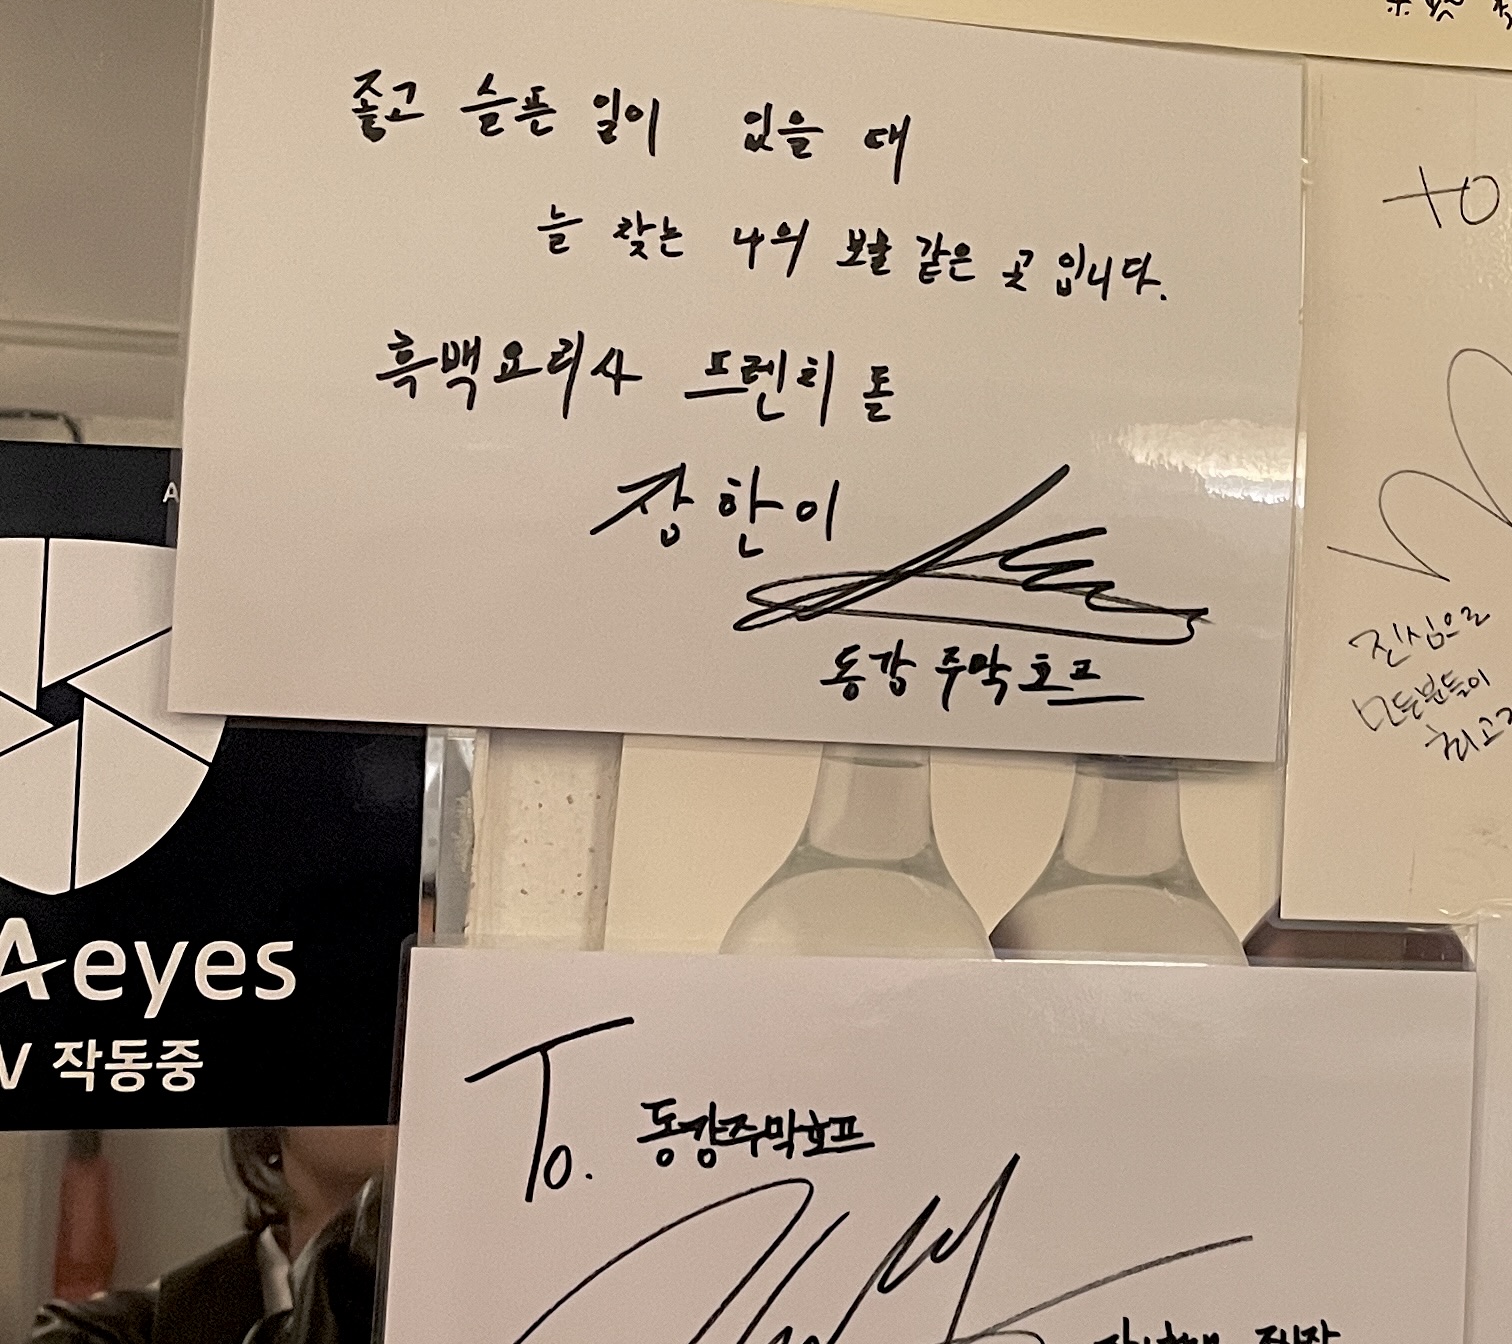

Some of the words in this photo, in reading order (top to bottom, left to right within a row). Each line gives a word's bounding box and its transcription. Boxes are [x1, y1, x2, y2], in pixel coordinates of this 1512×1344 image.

[459, 72, 558, 138] 슬픈
[592, 87, 660, 158] 일이
[536, 203, 584, 255] 늘
[612, 209, 684, 261] 찾는
[732, 218, 810, 279] 나의
[915, 231, 976, 285] 같은
[1055, 242, 1168, 302] 입니다.
[375, 328, 643, 421] 흑백요리사
[817, 636, 918, 704] 동강
[53, 1038, 204, 1093] 작동중
[463, 1016, 635, 1204] To.
